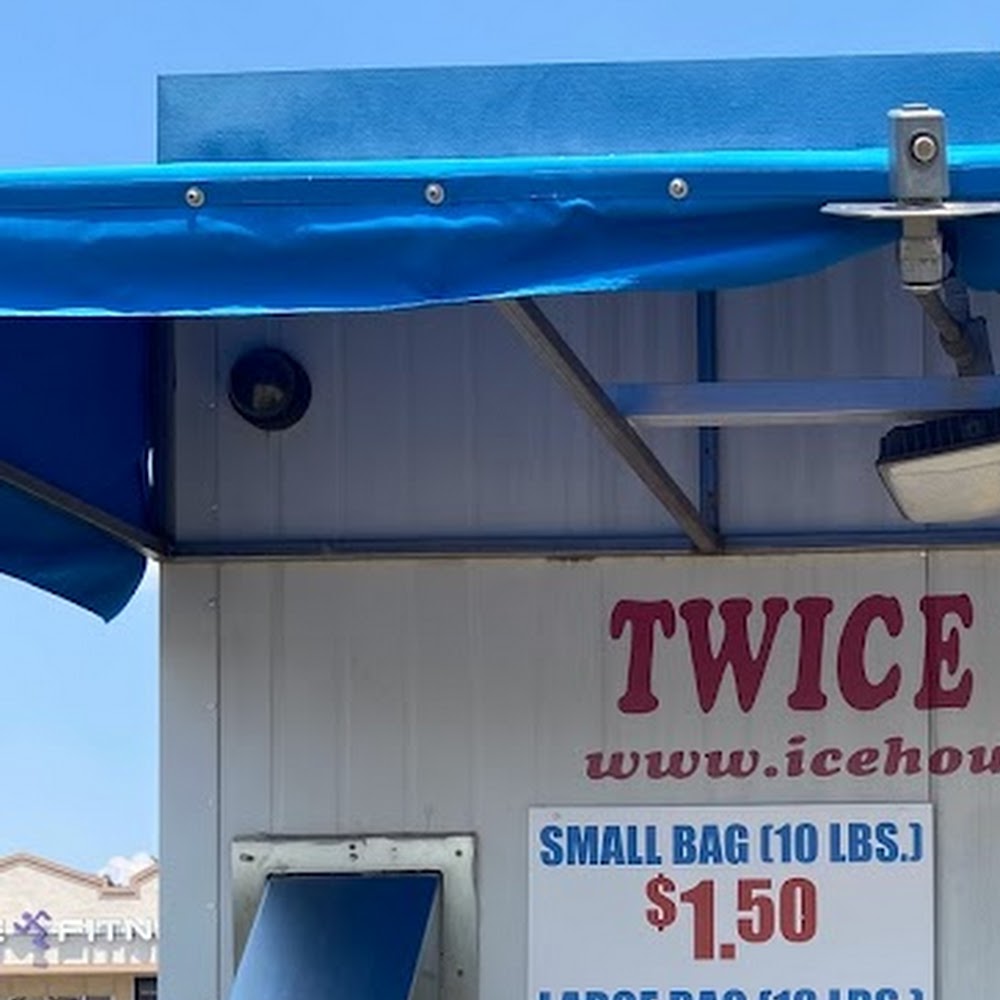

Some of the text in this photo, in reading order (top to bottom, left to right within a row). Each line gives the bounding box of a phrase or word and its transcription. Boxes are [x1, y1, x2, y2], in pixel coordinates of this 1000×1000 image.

[609, 594, 974, 714] TWICE
[540, 822, 924, 865] SMALL BAG (10 LBS.)
[58, 916, 158, 942] FITN
[645, 872, 818, 960] $1.50
